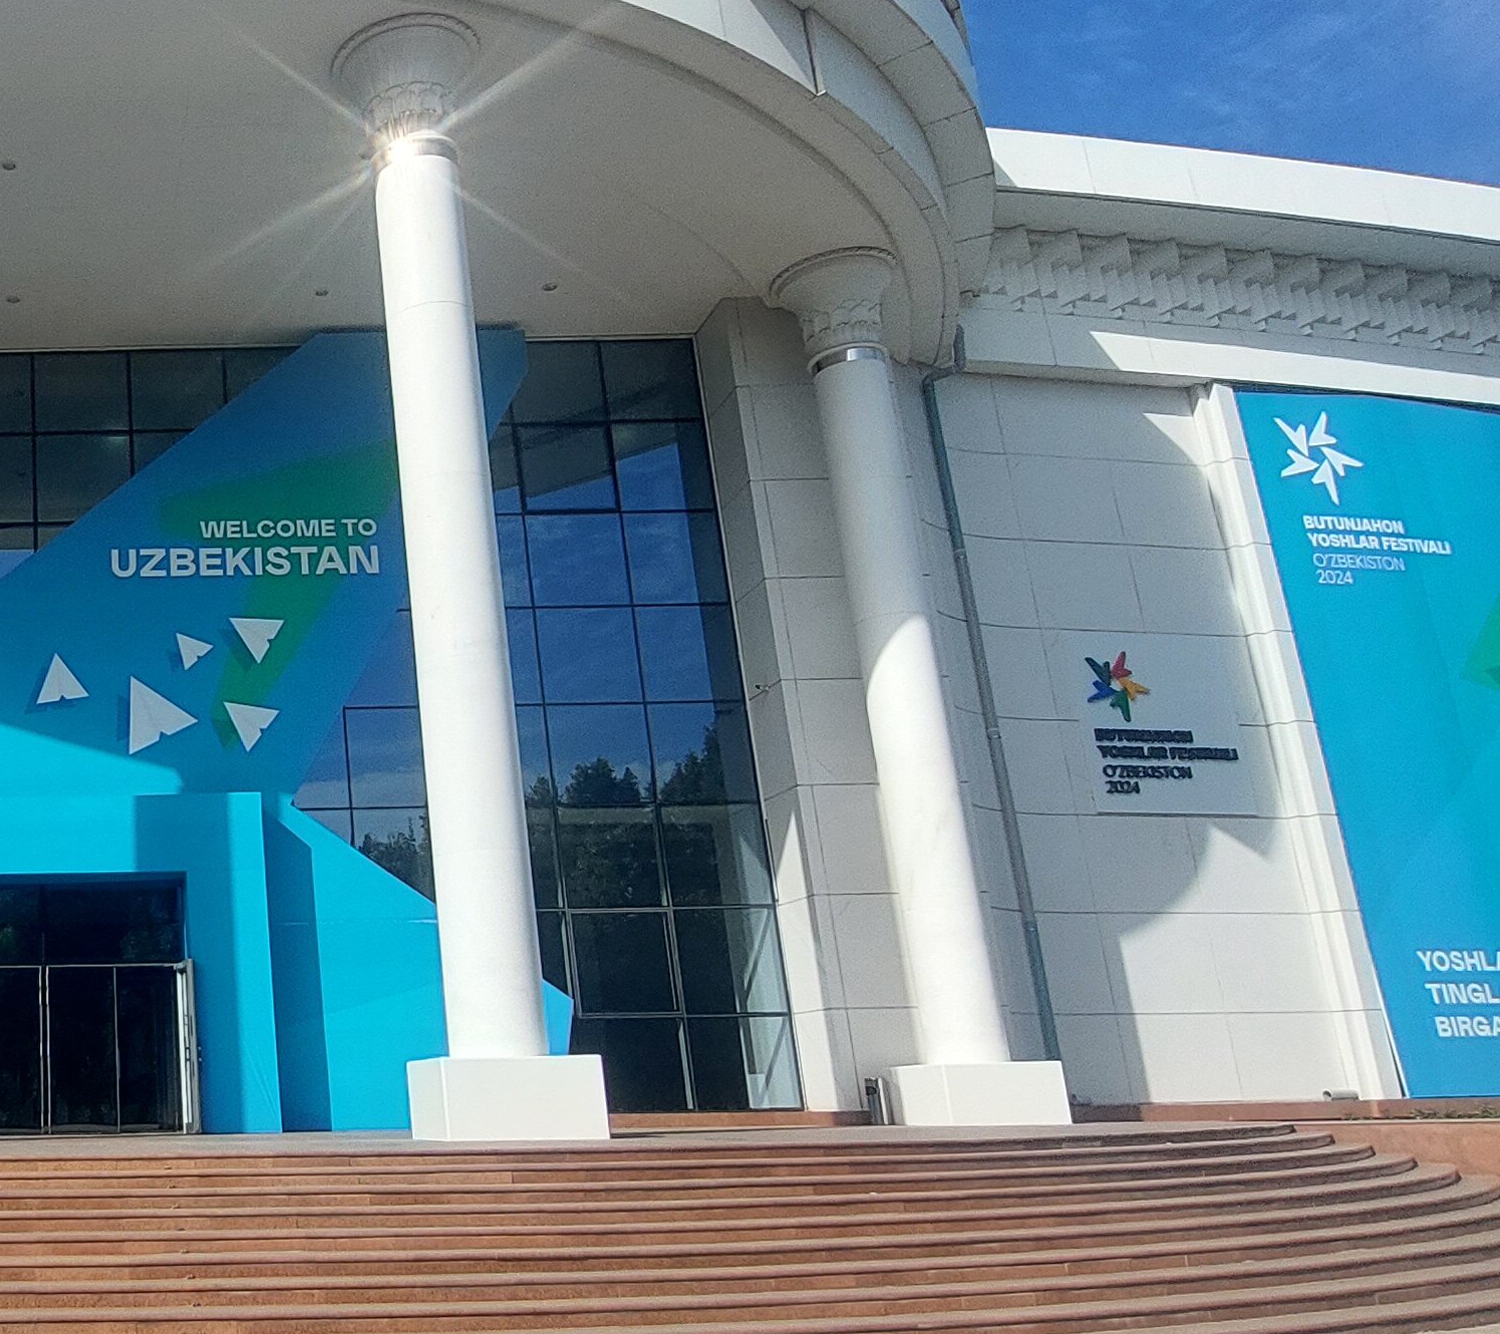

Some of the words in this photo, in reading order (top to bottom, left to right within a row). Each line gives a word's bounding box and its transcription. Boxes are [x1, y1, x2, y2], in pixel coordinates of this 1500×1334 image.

[200, 519, 336, 538] WELCOME
[341, 518, 377, 536] TO
[1303, 515, 1406, 534] BUTUNJAHON
[1307, 533, 1380, 550] YOSHLAR
[1382, 537, 1453, 555] FESTIVALI
[111, 545, 380, 578] UZBEKISTAN
[1316, 570, 1353, 584] 2024
[1416, 950, 1500, 972] YOSHL
[1424, 982, 1500, 1004] TINGL
